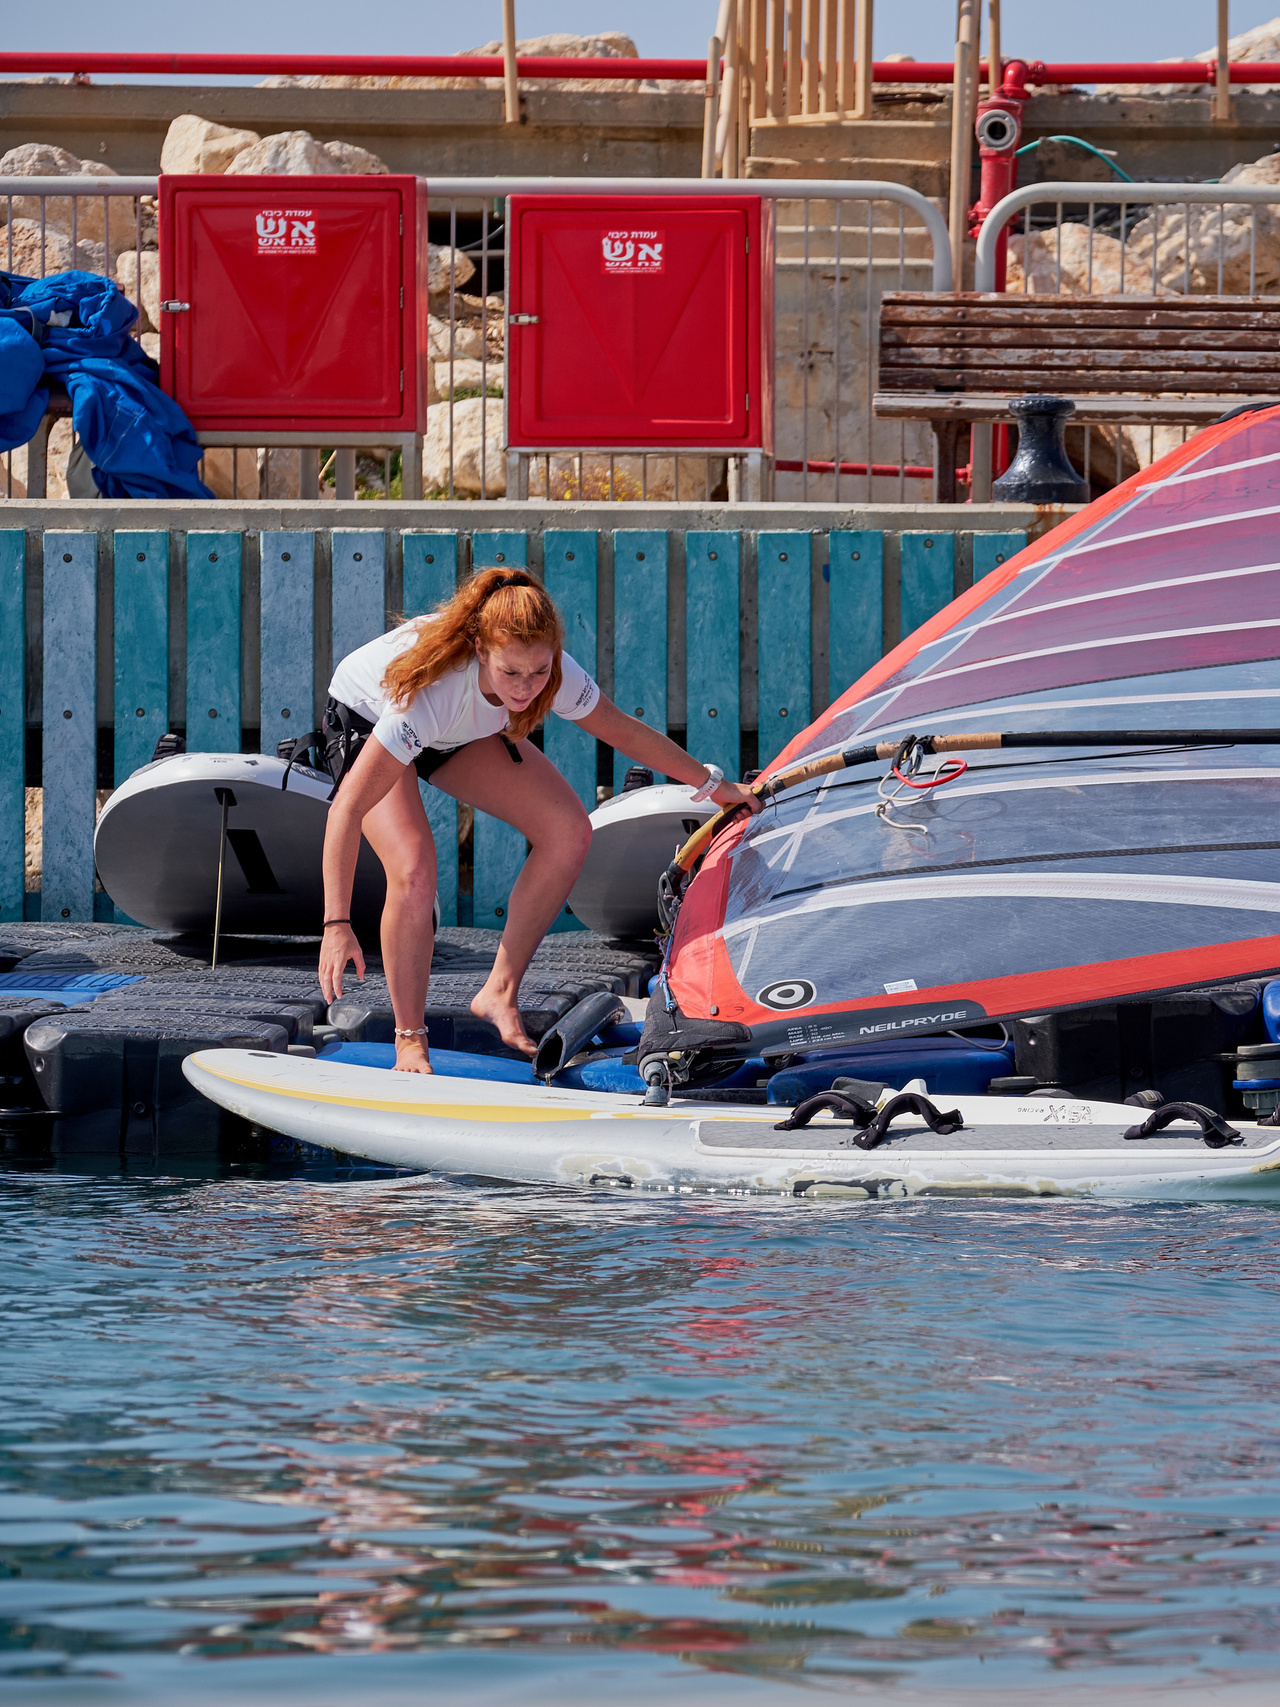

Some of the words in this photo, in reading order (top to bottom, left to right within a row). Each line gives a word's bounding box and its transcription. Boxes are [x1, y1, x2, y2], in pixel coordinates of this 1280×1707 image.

[255, 213, 316, 238] אש
[257, 238, 286, 246] אש
[608, 231, 628, 239] כיבוי
[630, 231, 658, 239] עמדת
[602, 236, 663, 261] אש
[859, 1010, 967, 1035] NEILPRYDE
